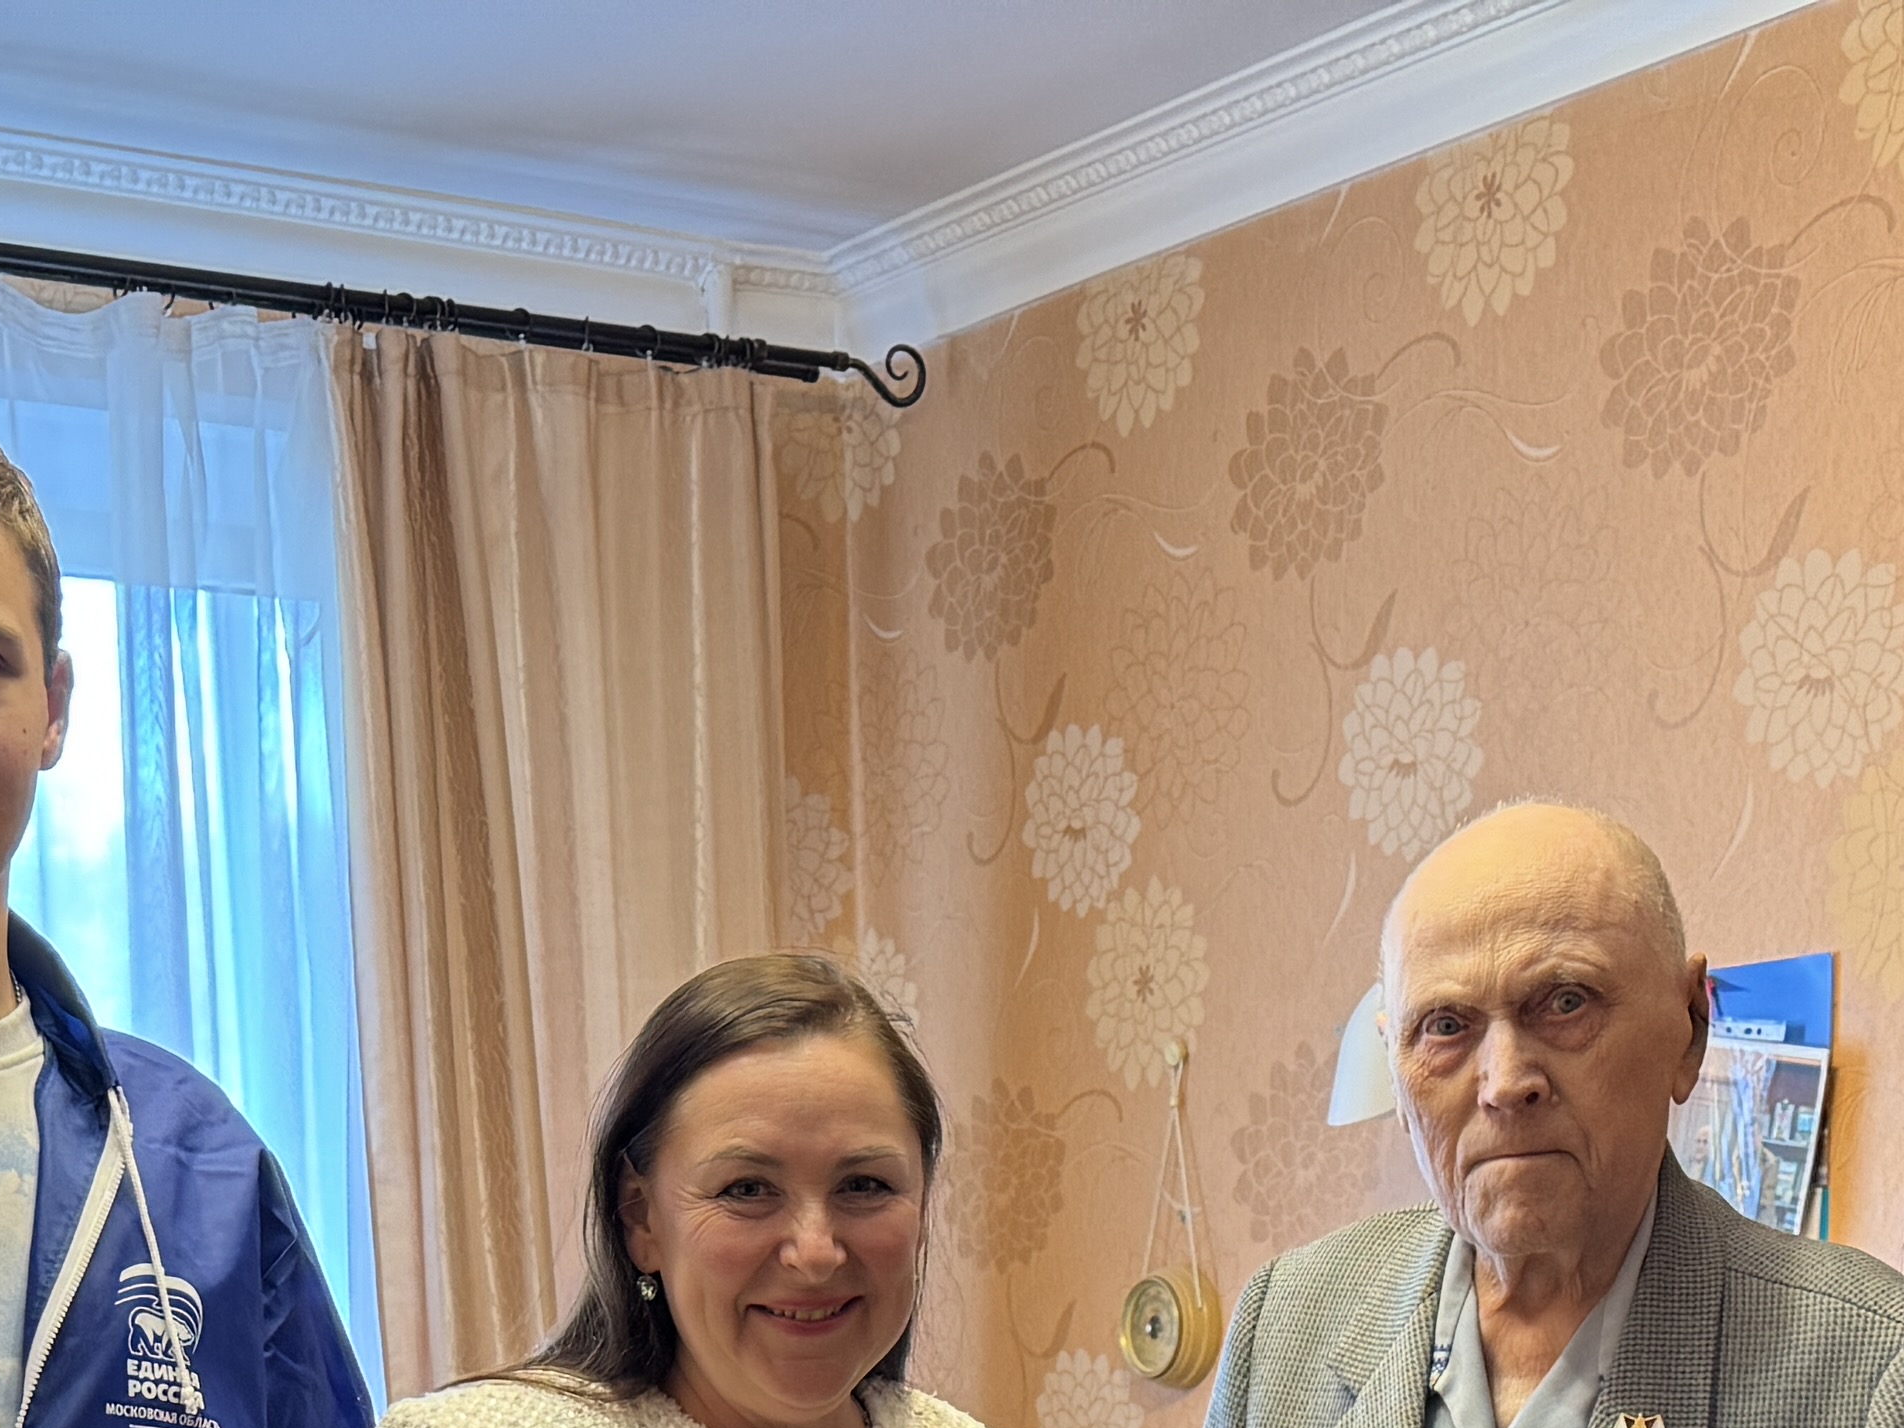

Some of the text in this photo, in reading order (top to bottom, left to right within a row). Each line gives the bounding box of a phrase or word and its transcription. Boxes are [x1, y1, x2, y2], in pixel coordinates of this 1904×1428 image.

[127, 1358, 200, 1390] ЕДИНЯ
[128, 1379, 205, 1410] РОССЯ
[105, 1402, 177, 1424] МОСКОВСКАЯ
